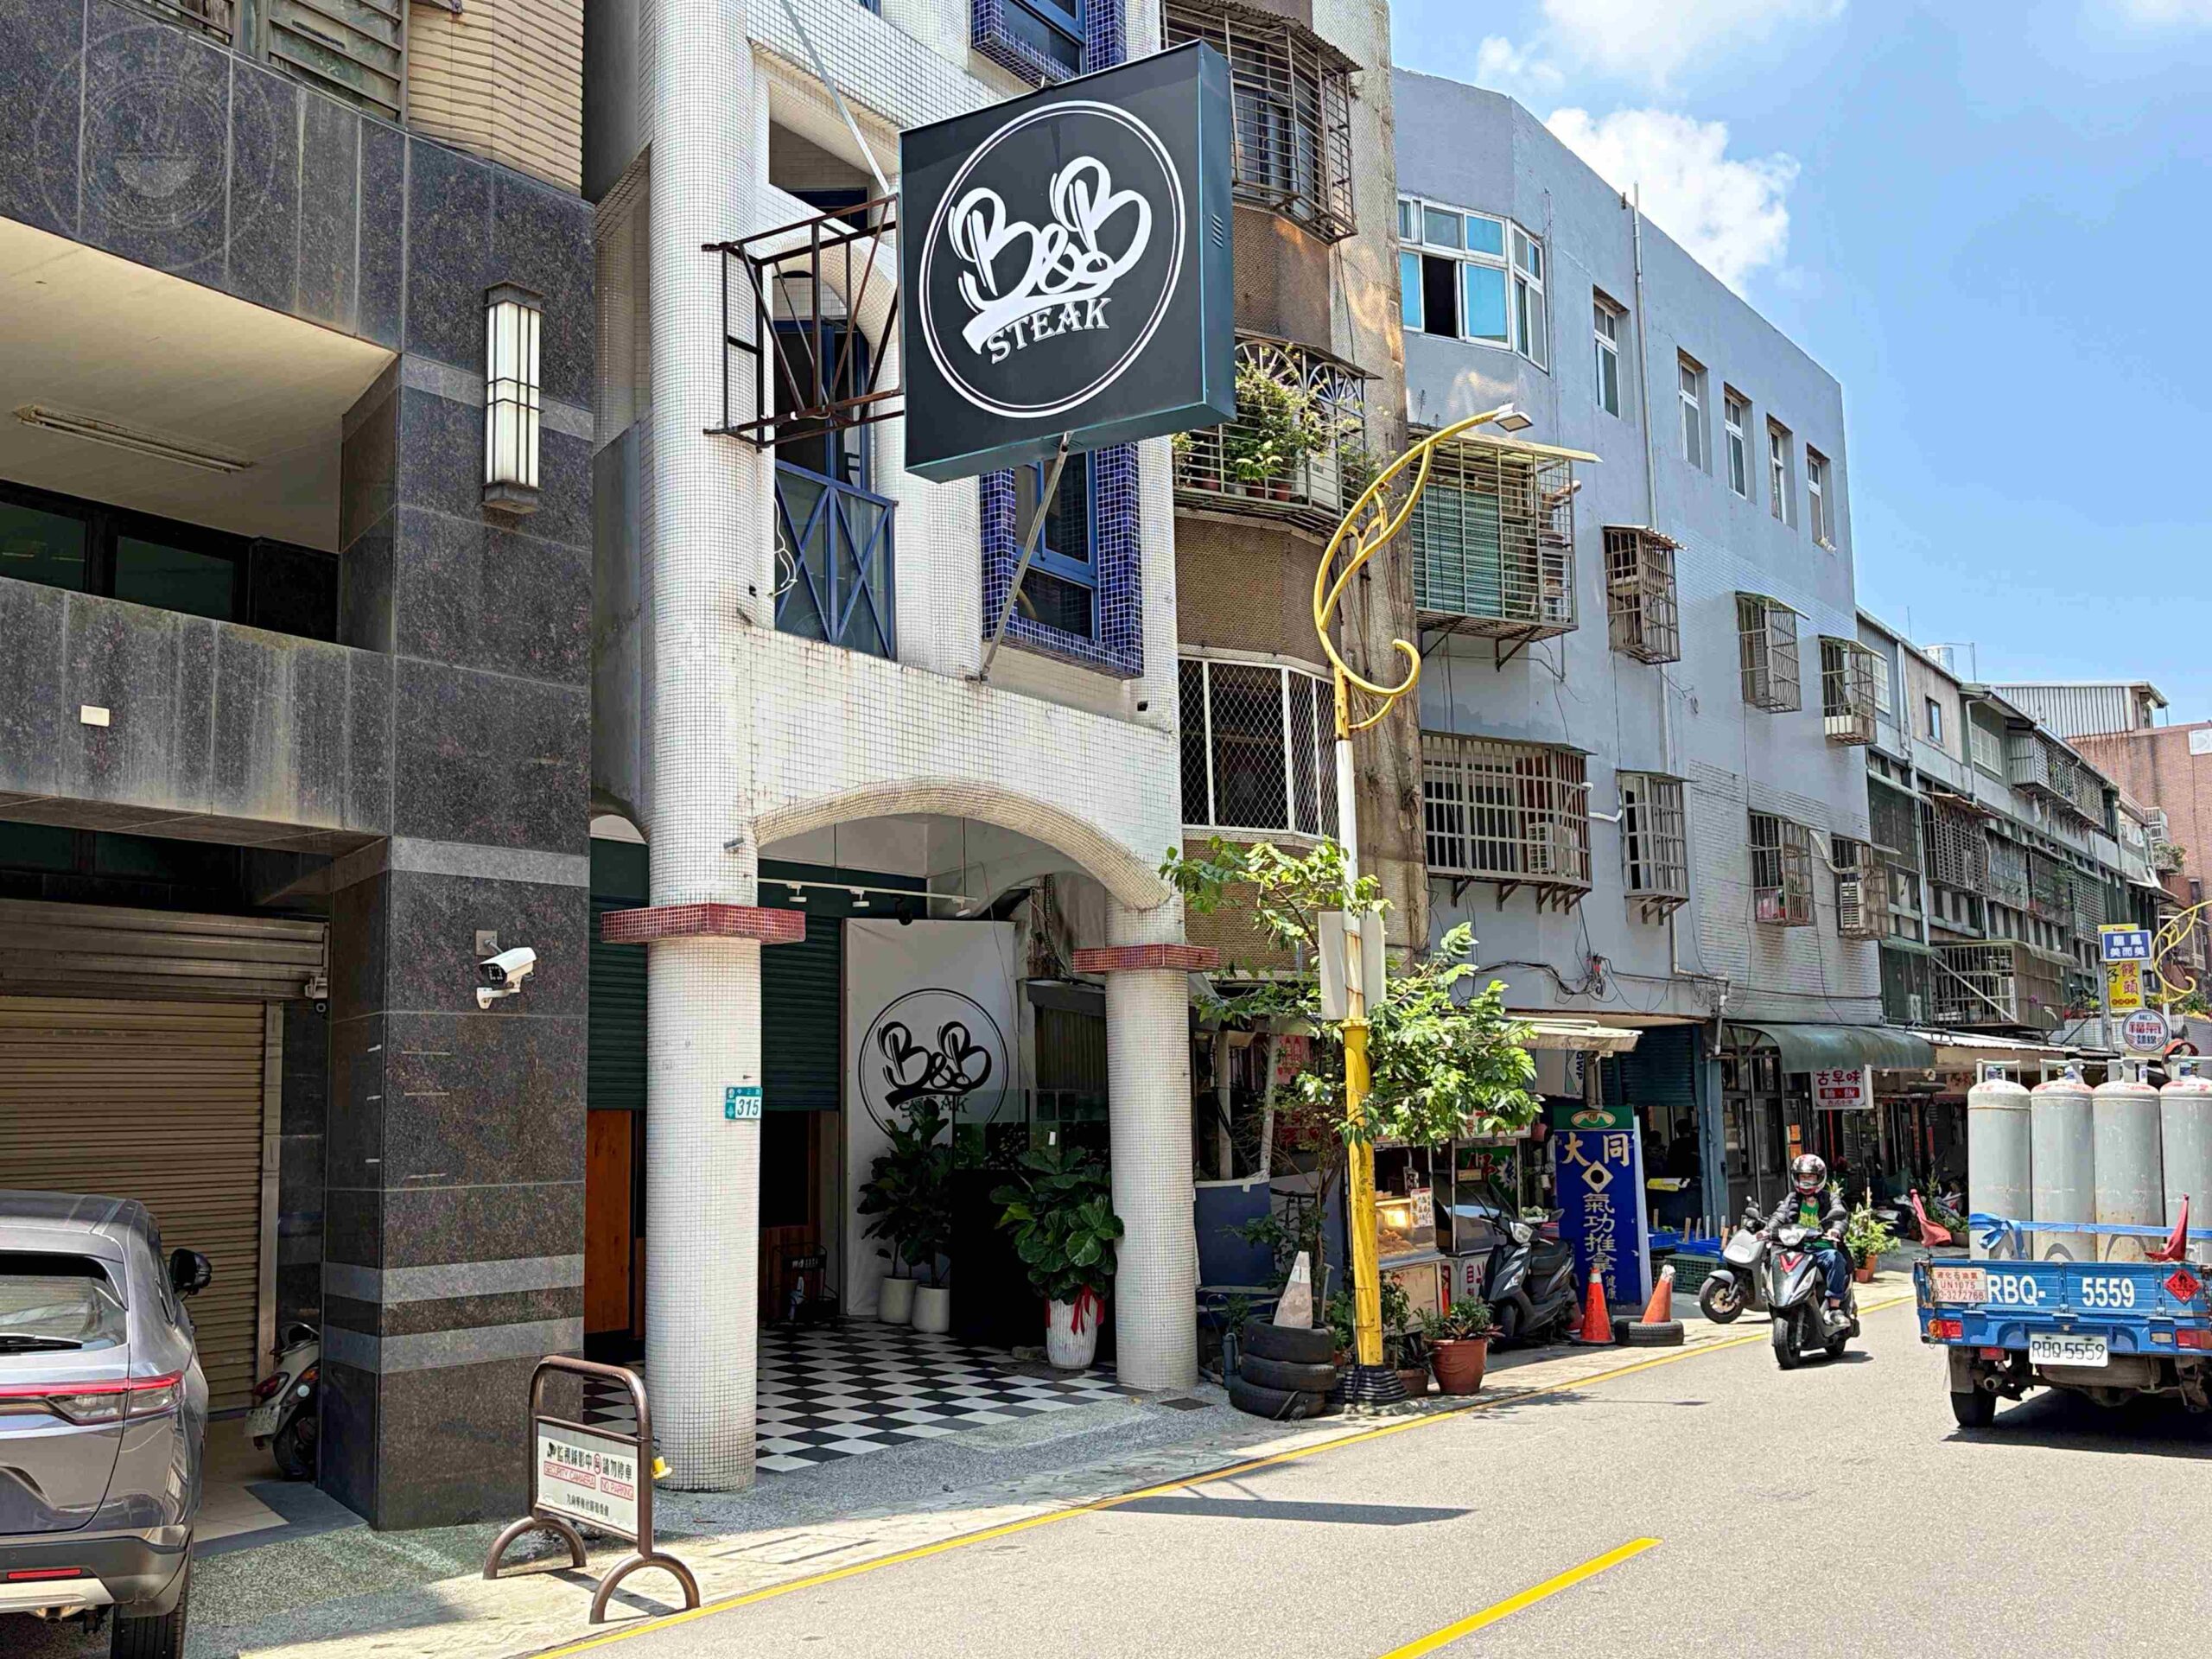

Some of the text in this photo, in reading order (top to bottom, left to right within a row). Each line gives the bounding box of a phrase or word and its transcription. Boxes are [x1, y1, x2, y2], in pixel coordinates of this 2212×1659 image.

[987, 298, 1110, 365] STEAK
[2109, 946, 2145, 957] 美而美
[2120, 962, 2139, 995] 饅頭
[1816, 1069, 1861, 1085] 古早味
[737, 1098, 760, 1116] 315
[899, 1096, 969, 1118] SAK
[1560, 1131, 1630, 1168] 大同
[1582, 1192, 1618, 1274] 氣功推拿
[1936, 1271, 1978, 1281] 液化石油氣
[2082, 1276, 2136, 1308] 5559
[2031, 1339, 2106, 1361] RBQ-5559
[602, 1457, 632, 1482] 請勿停車
